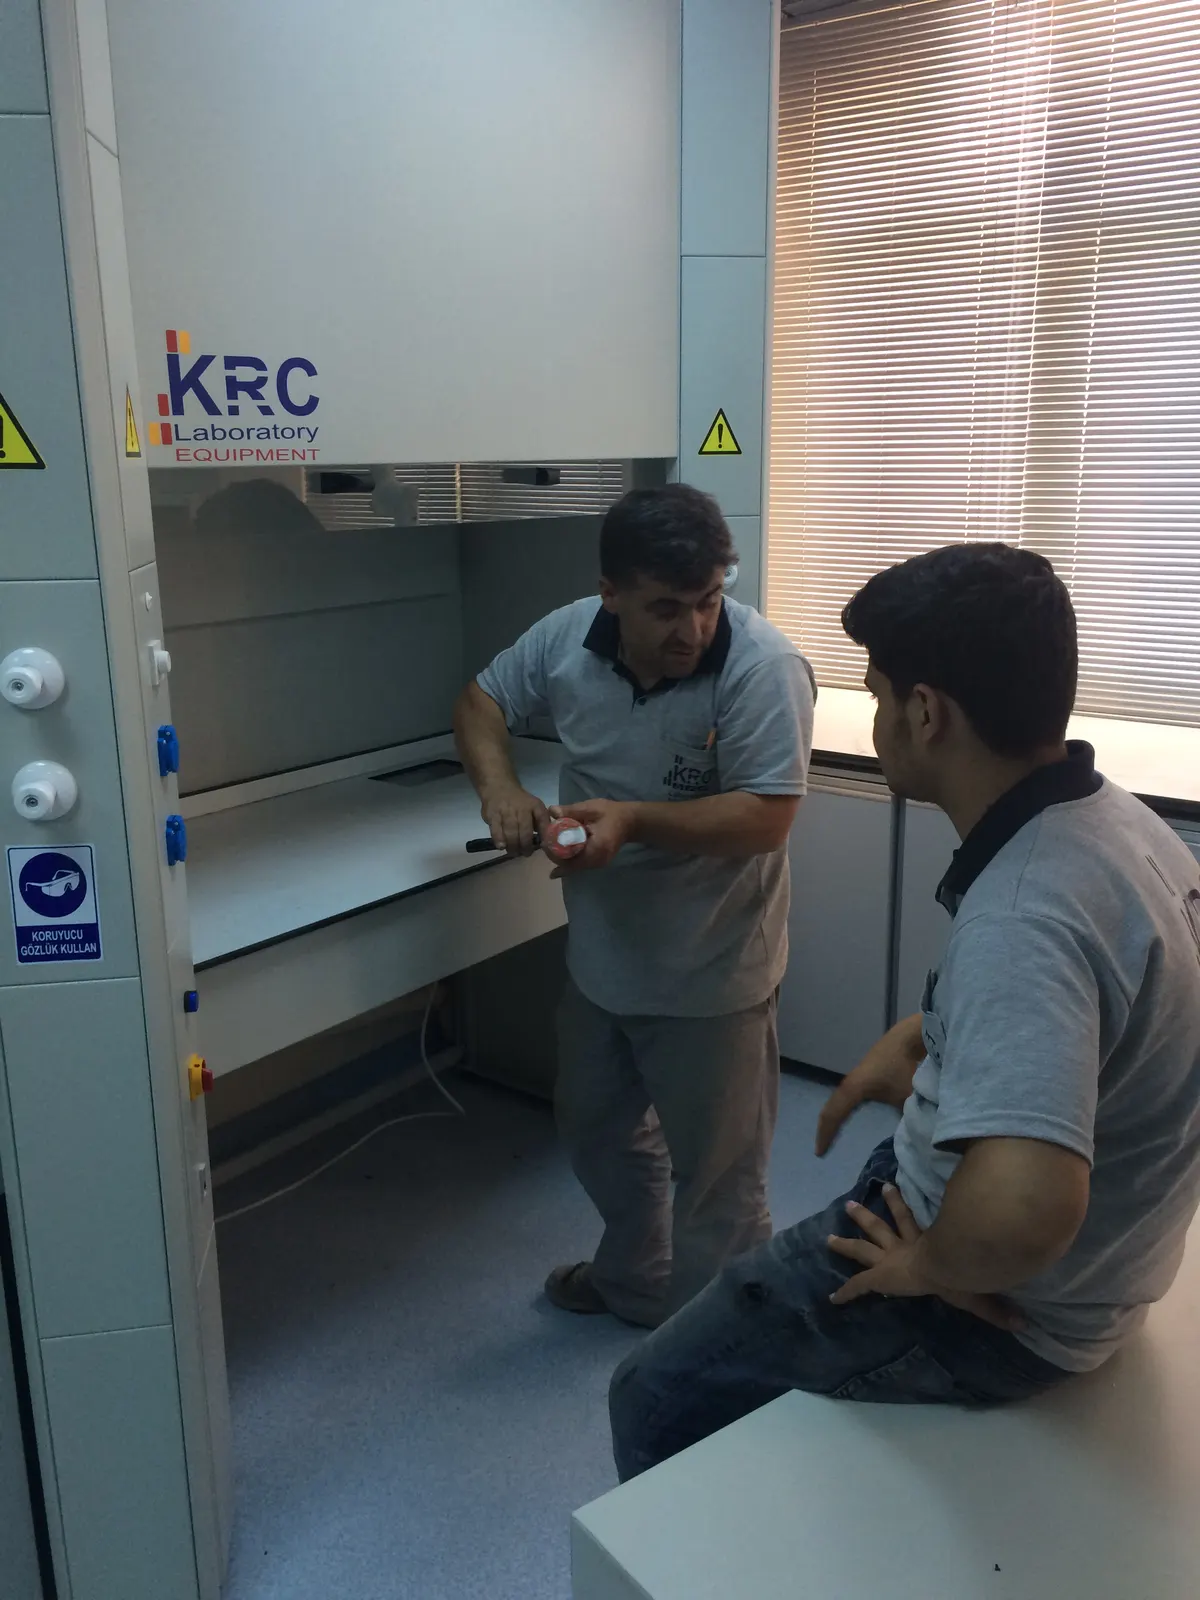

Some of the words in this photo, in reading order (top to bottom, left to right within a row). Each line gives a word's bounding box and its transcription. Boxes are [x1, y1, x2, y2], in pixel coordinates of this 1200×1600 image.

[166, 354, 320, 416] KRC
[174, 423, 319, 443] Laboratory
[175, 448, 321, 462] EQUIPMENT
[32, 929, 83, 941] KORUYUCU
[20, 943, 58, 956] GÖZLÜK
[60, 943, 97, 954] KULLAN
